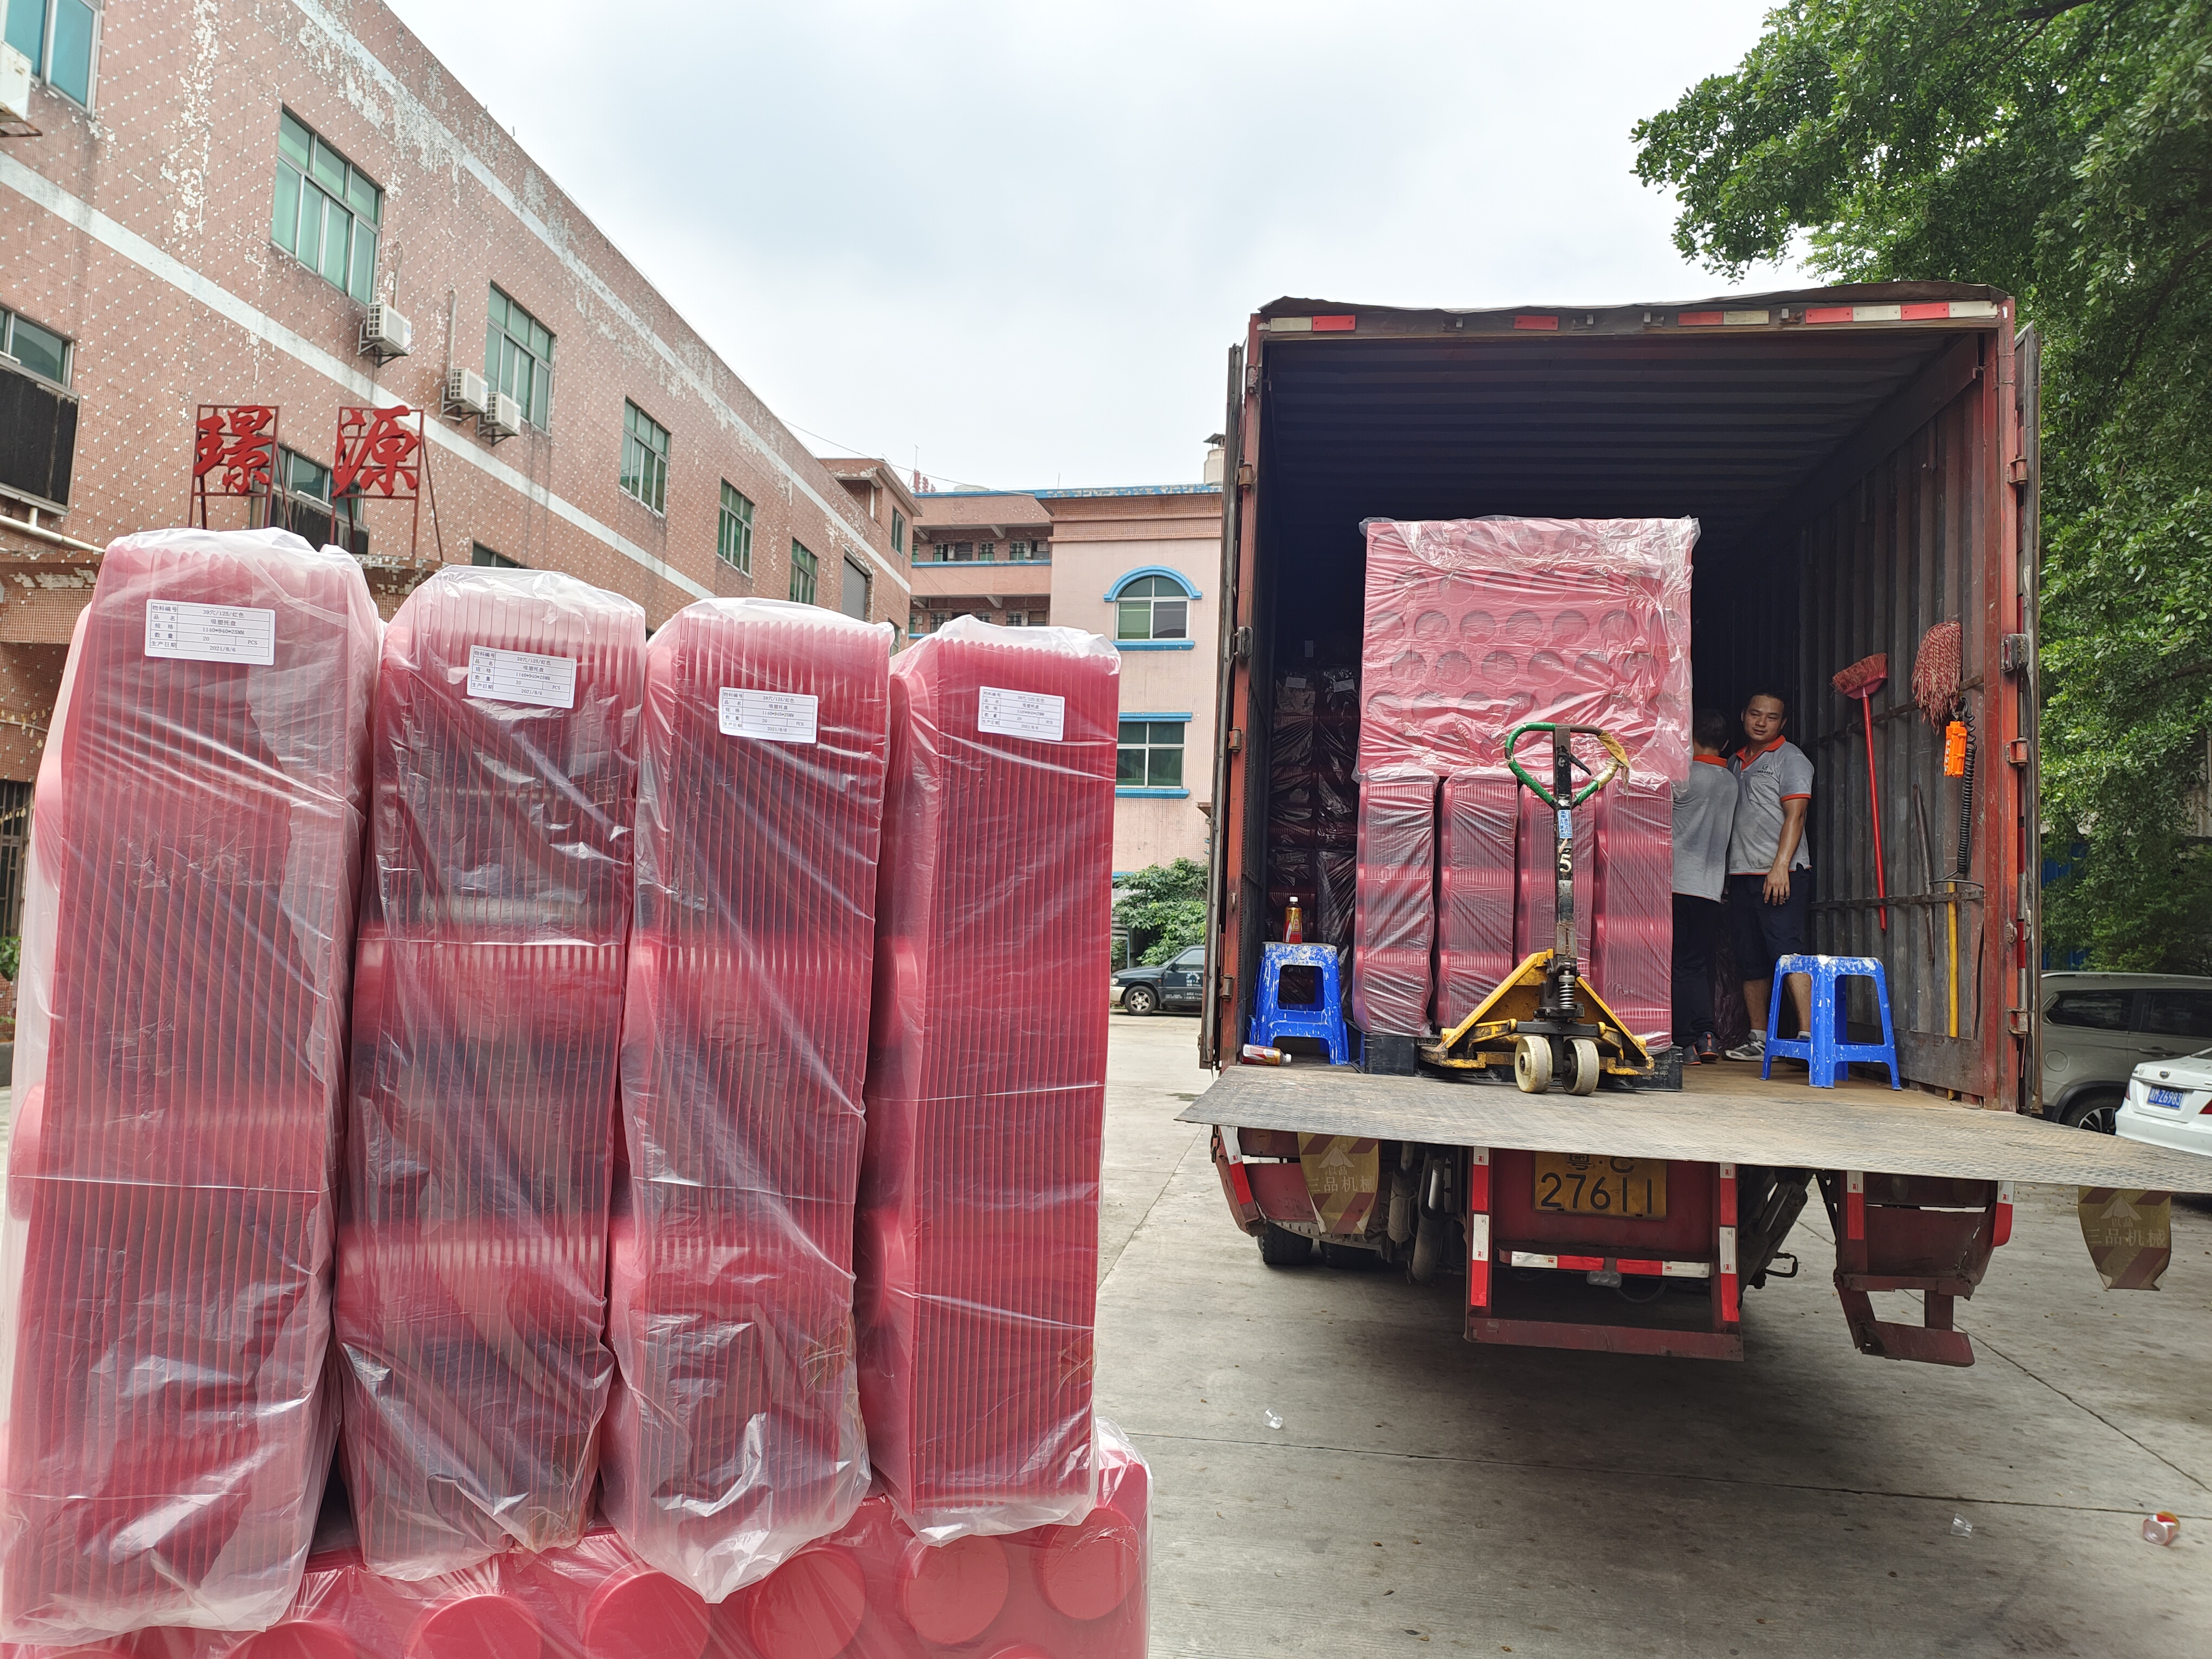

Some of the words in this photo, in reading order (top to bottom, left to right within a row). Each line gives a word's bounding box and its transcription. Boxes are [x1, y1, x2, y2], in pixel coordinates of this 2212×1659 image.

[1560, 854, 1572, 872] 5
[1306, 1175, 1375, 1192] 三品机械
[1541, 1172, 1652, 1214] 27611
[2085, 1227, 2166, 1246] 三品机械
